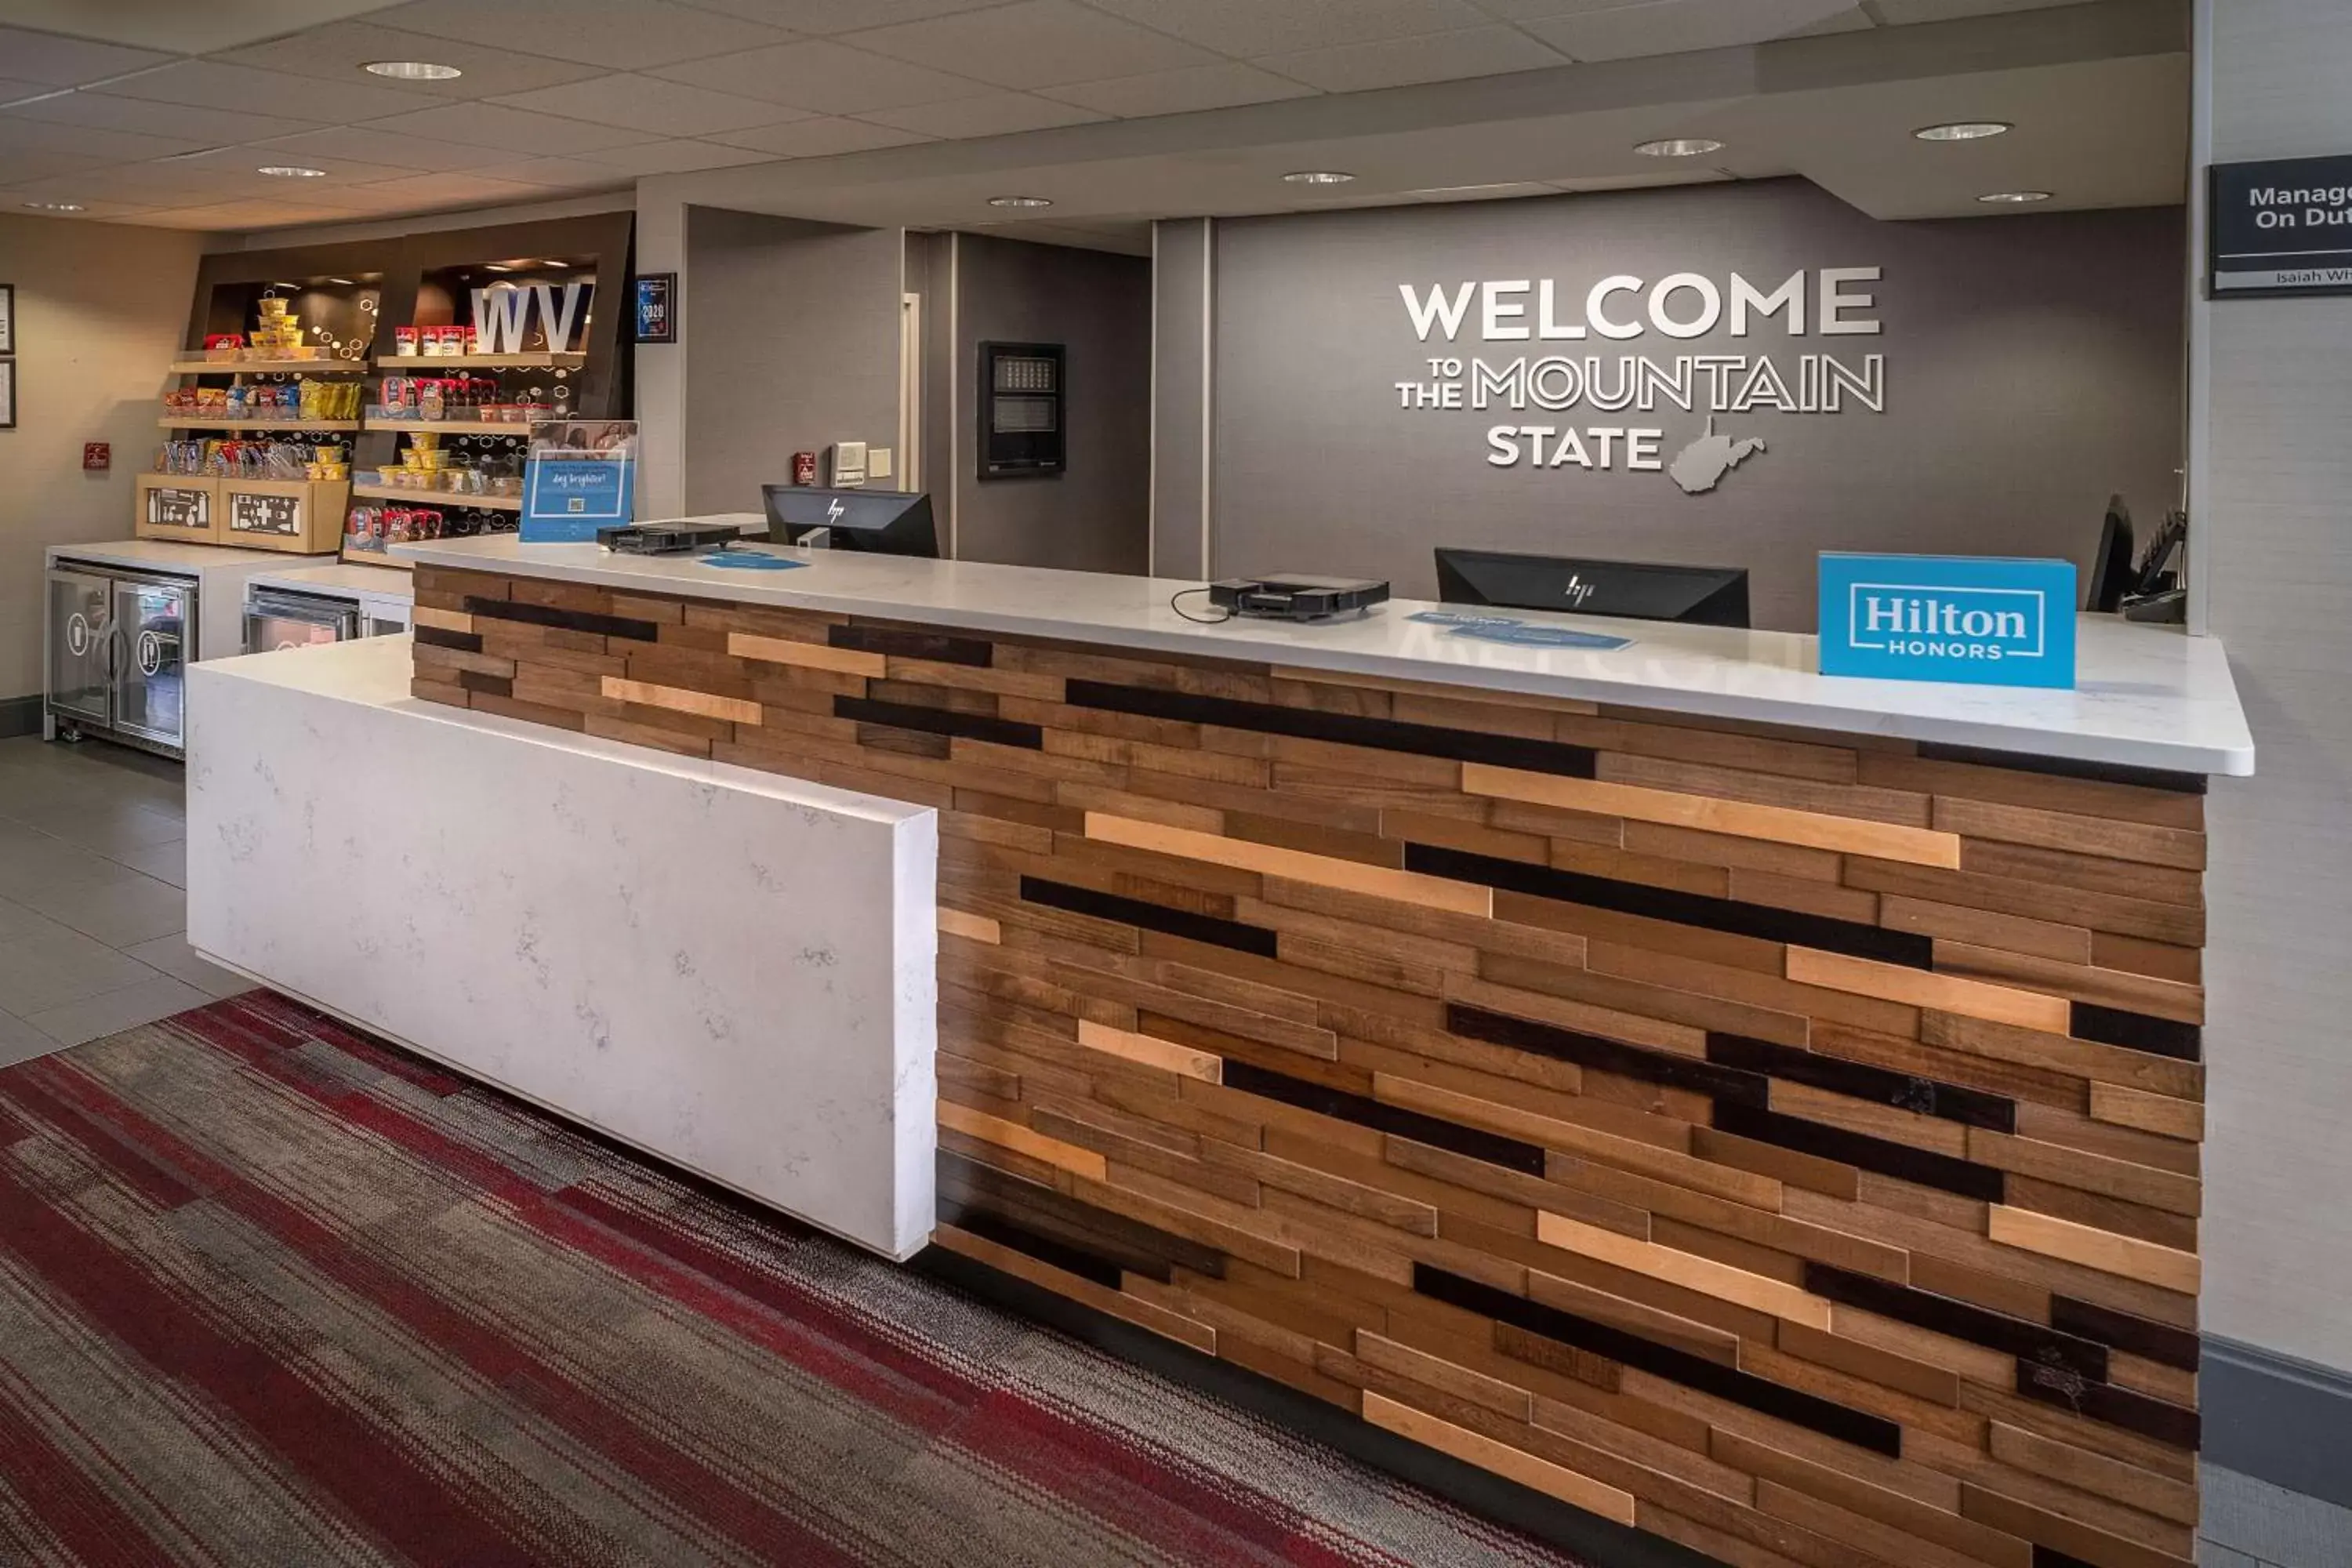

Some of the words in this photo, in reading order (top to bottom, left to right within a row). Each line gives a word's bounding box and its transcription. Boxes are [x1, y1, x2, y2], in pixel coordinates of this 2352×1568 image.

[2256, 210, 2296, 228] On
[2277, 270, 2321, 283] Isaiah
[471, 283, 581, 354] WV
[1399, 267, 1882, 341] WELCOME
[1395, 383, 1462, 408] THE
[1472, 354, 1883, 412] MOUNTAIN
[1427, 358, 1462, 377] TO
[1487, 425, 1662, 469] STATE
[827, 498, 845, 524] hp
[1866, 596, 2027, 639] Hilton
[1889, 640, 2003, 660] HONORS
